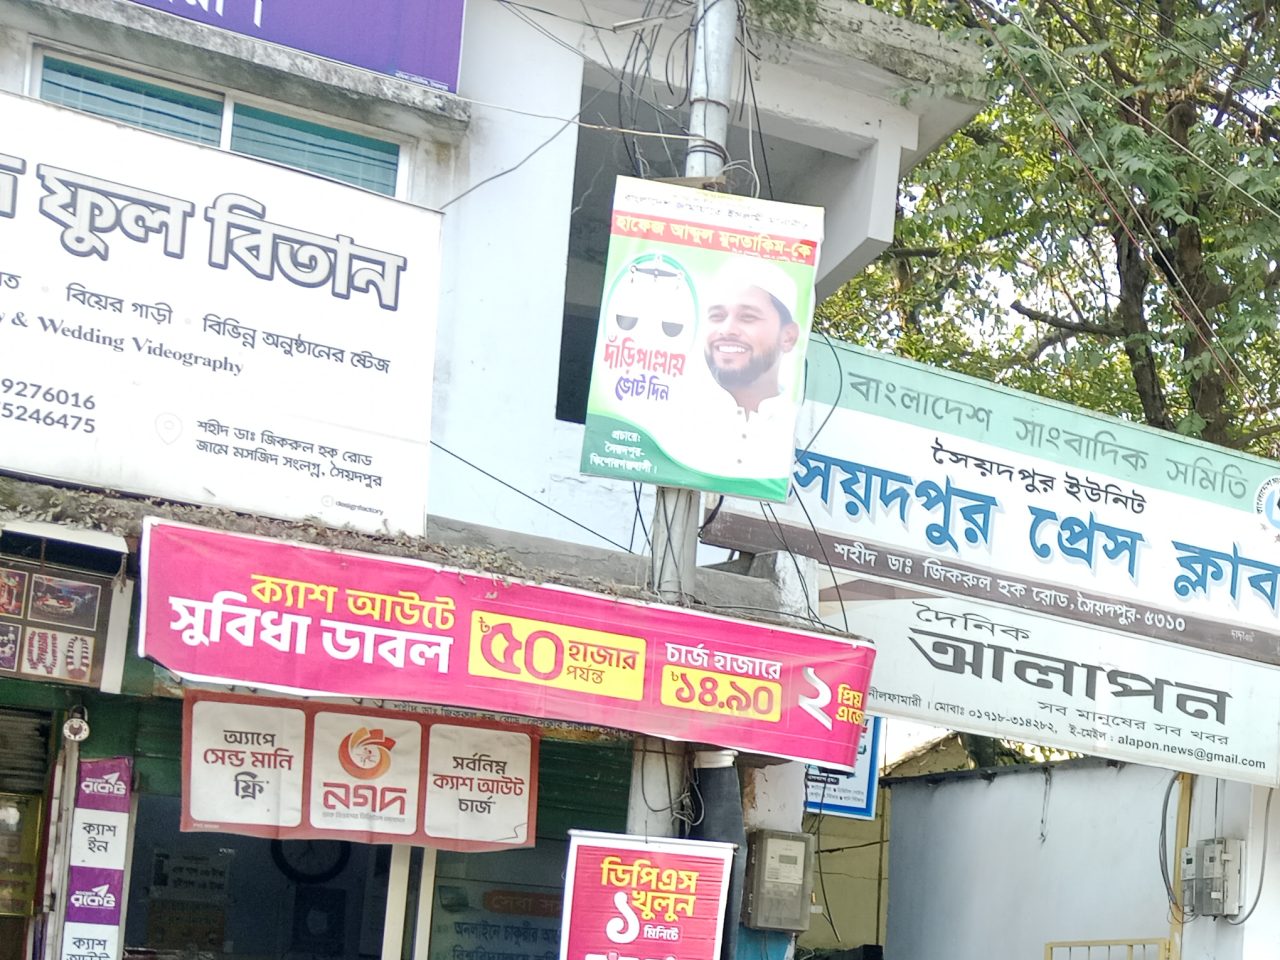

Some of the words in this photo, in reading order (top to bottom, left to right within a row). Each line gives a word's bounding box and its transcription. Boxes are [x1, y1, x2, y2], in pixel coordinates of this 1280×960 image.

[37, 163, 195, 263] ফুল
[205, 193, 407, 312] বিতান
[66, 282, 124, 314] বিয়ের
[131, 301, 173, 325] গাড়ী
[202, 313, 257, 349] বিভিন্ন
[262, 331, 345, 364] অনুষ্ঠানের
[12, 312, 28, 328] &
[38, 316, 125, 352] Wedding
[131, 336, 245, 376] Videography
[615, 374, 645, 401] ভোট
[648, 376, 669, 402] দিন
[197, 419, 229, 438] শহীদ
[318, 443, 339, 459] হক
[342, 448, 372, 466] রোড
[848, 370, 993, 433] বাংলাদেশ
[1014, 415, 1149, 473] সাংবাদিক
[1165, 457, 1249, 501] সমিতি
[196, 439, 229, 458] জামে
[233, 445, 279, 467] মসজিদ
[328, 460, 383, 489] সৈয়দপুর
[932, 438, 1056, 494] সৈয়দপুর
[1064, 470, 1147, 514] ইউনিট
[1029, 502, 1145, 577] প্রেস
[250, 573, 338, 614] ক্যাশ
[345, 589, 456, 630] আউটে
[834, 542, 878, 567] শহীদ
[887, 551, 912, 575] ডাঃ
[922, 559, 991, 592] জিকরুল
[998, 577, 1026, 599] হক
[1144, 613, 1186, 632] ৫৩১০
[168, 589, 312, 655] সুবিধা
[320, 618, 454, 674] ডাবল
[913, 600, 1033, 642] দৈনিক
[565, 663, 605, 685] পর্যন্ত
[568, 639, 640, 671] হাজার
[665, 641, 709, 668] চার্জ
[713, 649, 782, 680] হাজারে
[907, 627, 1233, 726] আলাপন
[224, 729, 275, 747] অ্যাপে
[1037, 699, 1067, 716] সব
[1075, 708, 1146, 732] মানুষের
[1155, 722, 1182, 739] সব
[1190, 729, 1231, 746] খবর
[203, 748, 247, 766] সেন্ড
[250, 747, 294, 771] মানি
[452, 754, 508, 776] সর্বনিম্ন
[1117, 733, 1267, 770] alapon.news@gmail.com
[233, 771, 264, 800] ফ্রি
[322, 782, 407, 816] নগদ
[432, 773, 473, 791] ক্যাশ
[477, 776, 525, 797] আউট
[458, 797, 492, 815] চার্জ
[83, 822, 117, 837] ক্যাশ
[88, 836, 108, 853] ইন
[601, 856, 699, 894] ডিপিএস
[606, 891, 640, 943] ১
[643, 924, 680, 942] মিনিটে
[632, 889, 696, 922] খুলুন
[72, 937, 107, 952] ক্যাশ
